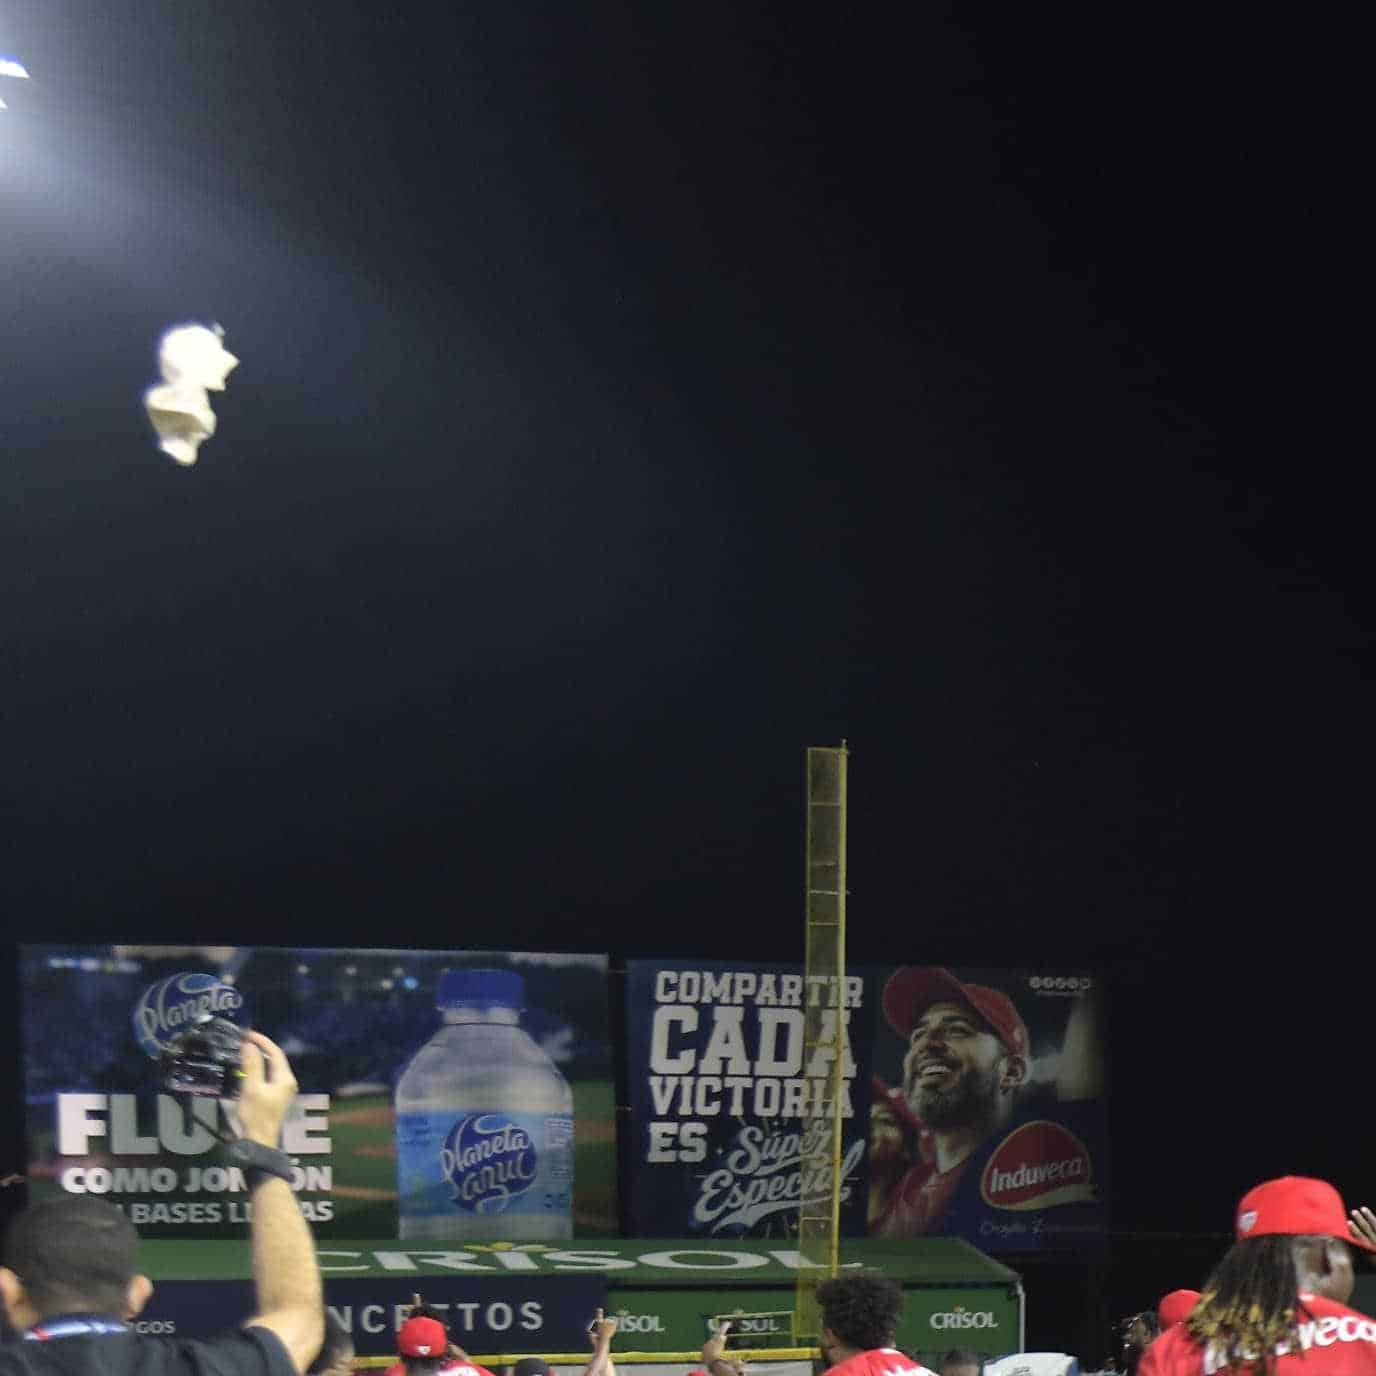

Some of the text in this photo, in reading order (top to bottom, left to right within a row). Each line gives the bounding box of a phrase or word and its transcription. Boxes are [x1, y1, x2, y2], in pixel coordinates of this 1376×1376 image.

[655, 970, 863, 1009] COMPARTIR
[649, 1004, 858, 1079] CADA
[648, 1076, 854, 1119] VICTORIA
[58, 1093, 332, 1155] FLUE
[646, 1121, 708, 1163] ES
[61, 1167, 177, 1194] COMO
[692, 1138, 866, 1222] Especial
[990, 1154, 1083, 1193] Induveca
[131, 1203, 222, 1223] BASES
[930, 1310, 998, 1329] CRISOL
